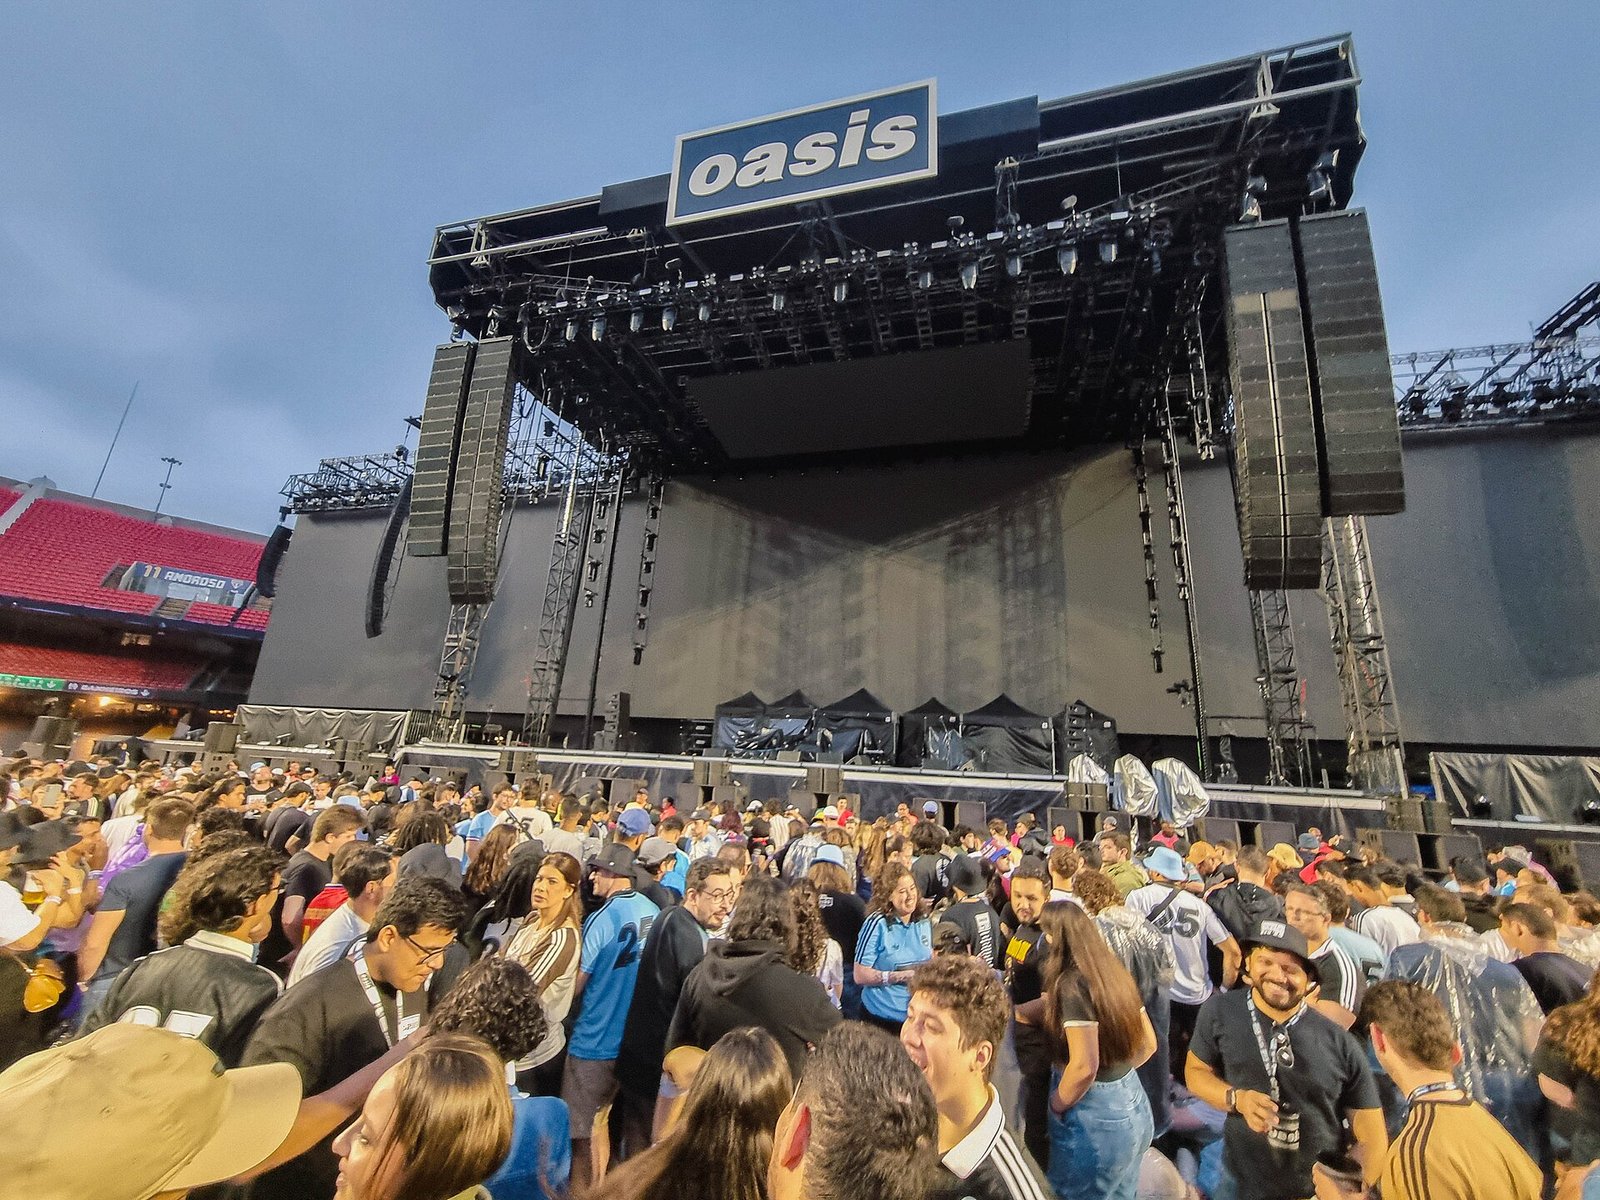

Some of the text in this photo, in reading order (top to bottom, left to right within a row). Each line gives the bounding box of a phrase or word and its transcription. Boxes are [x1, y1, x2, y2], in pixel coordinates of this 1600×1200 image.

[688, 108, 918, 197] oasis
[143, 565, 226, 589] 11 AMOROSO
